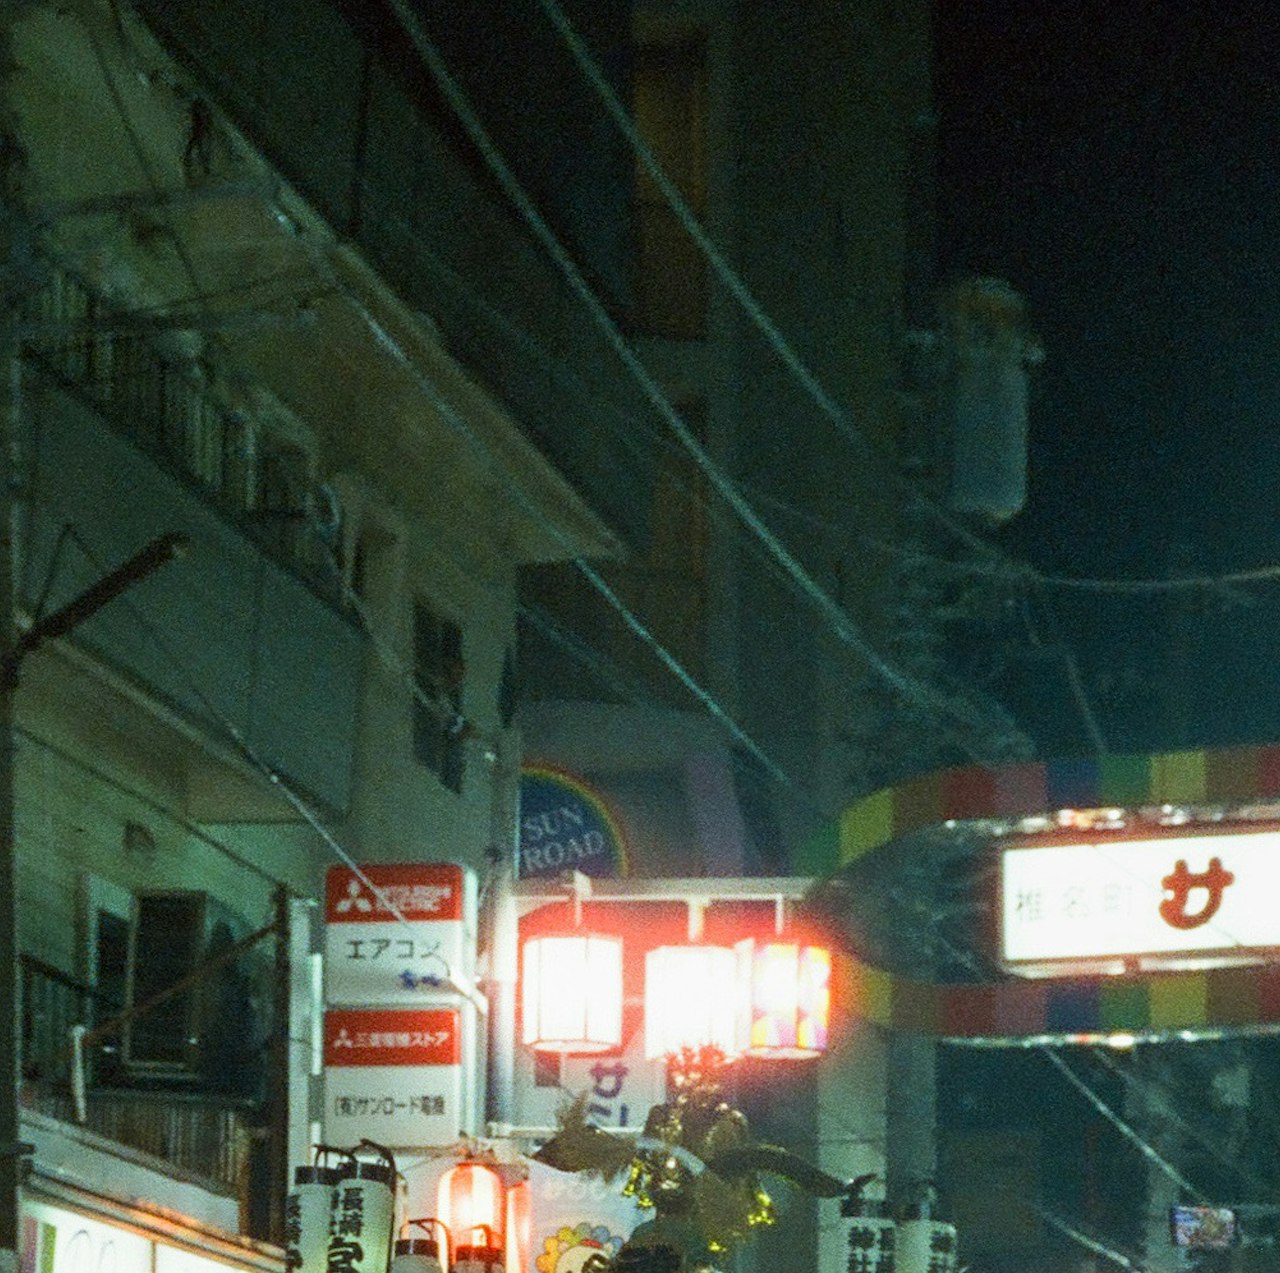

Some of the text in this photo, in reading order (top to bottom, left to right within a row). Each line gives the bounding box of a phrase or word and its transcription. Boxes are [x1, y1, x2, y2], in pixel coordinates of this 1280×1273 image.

[524, 803, 585, 842] SUN
[523, 829, 607, 874] ROAD
[346, 938, 441, 960] エアコン
